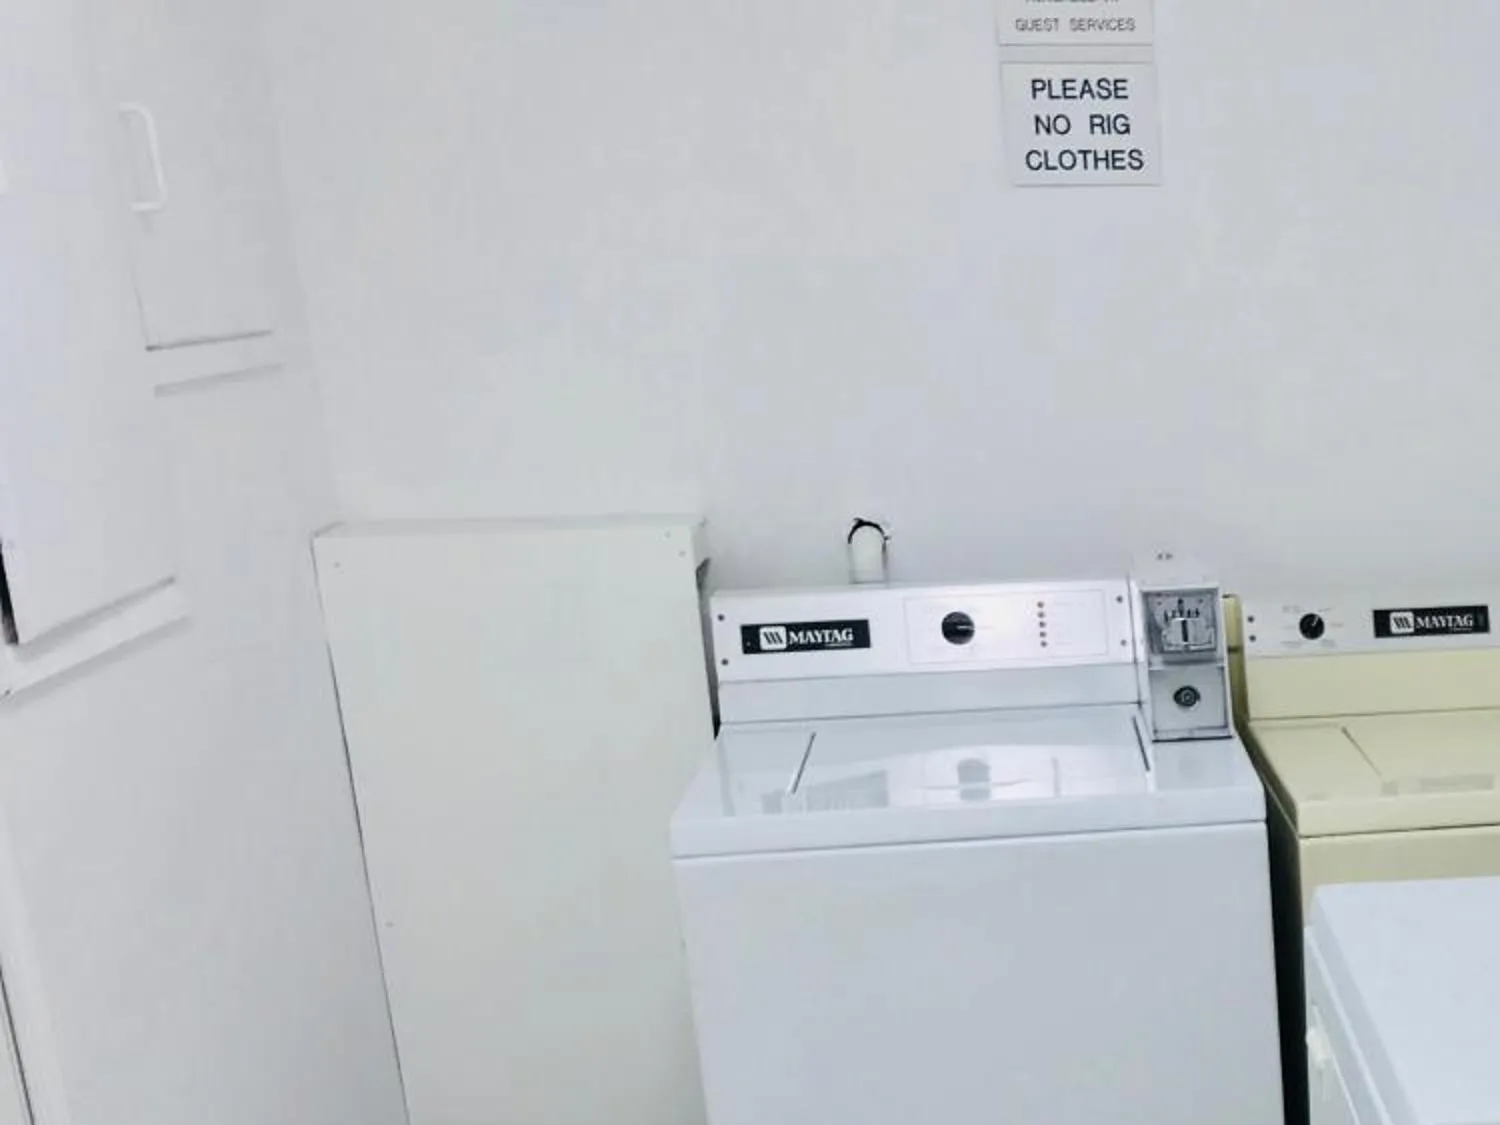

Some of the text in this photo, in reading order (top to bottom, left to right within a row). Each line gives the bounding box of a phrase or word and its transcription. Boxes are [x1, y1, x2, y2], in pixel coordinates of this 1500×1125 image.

[1015, 17, 1136, 32] GUEST SERVICES
[1031, 78, 1129, 100] PLEASE
[1034, 113, 1131, 135] NO RIG
[1025, 149, 1144, 171] CLOTHES
[1416, 614, 1473, 630] MAYTAG
[788, 627, 854, 645] MAYTAG
